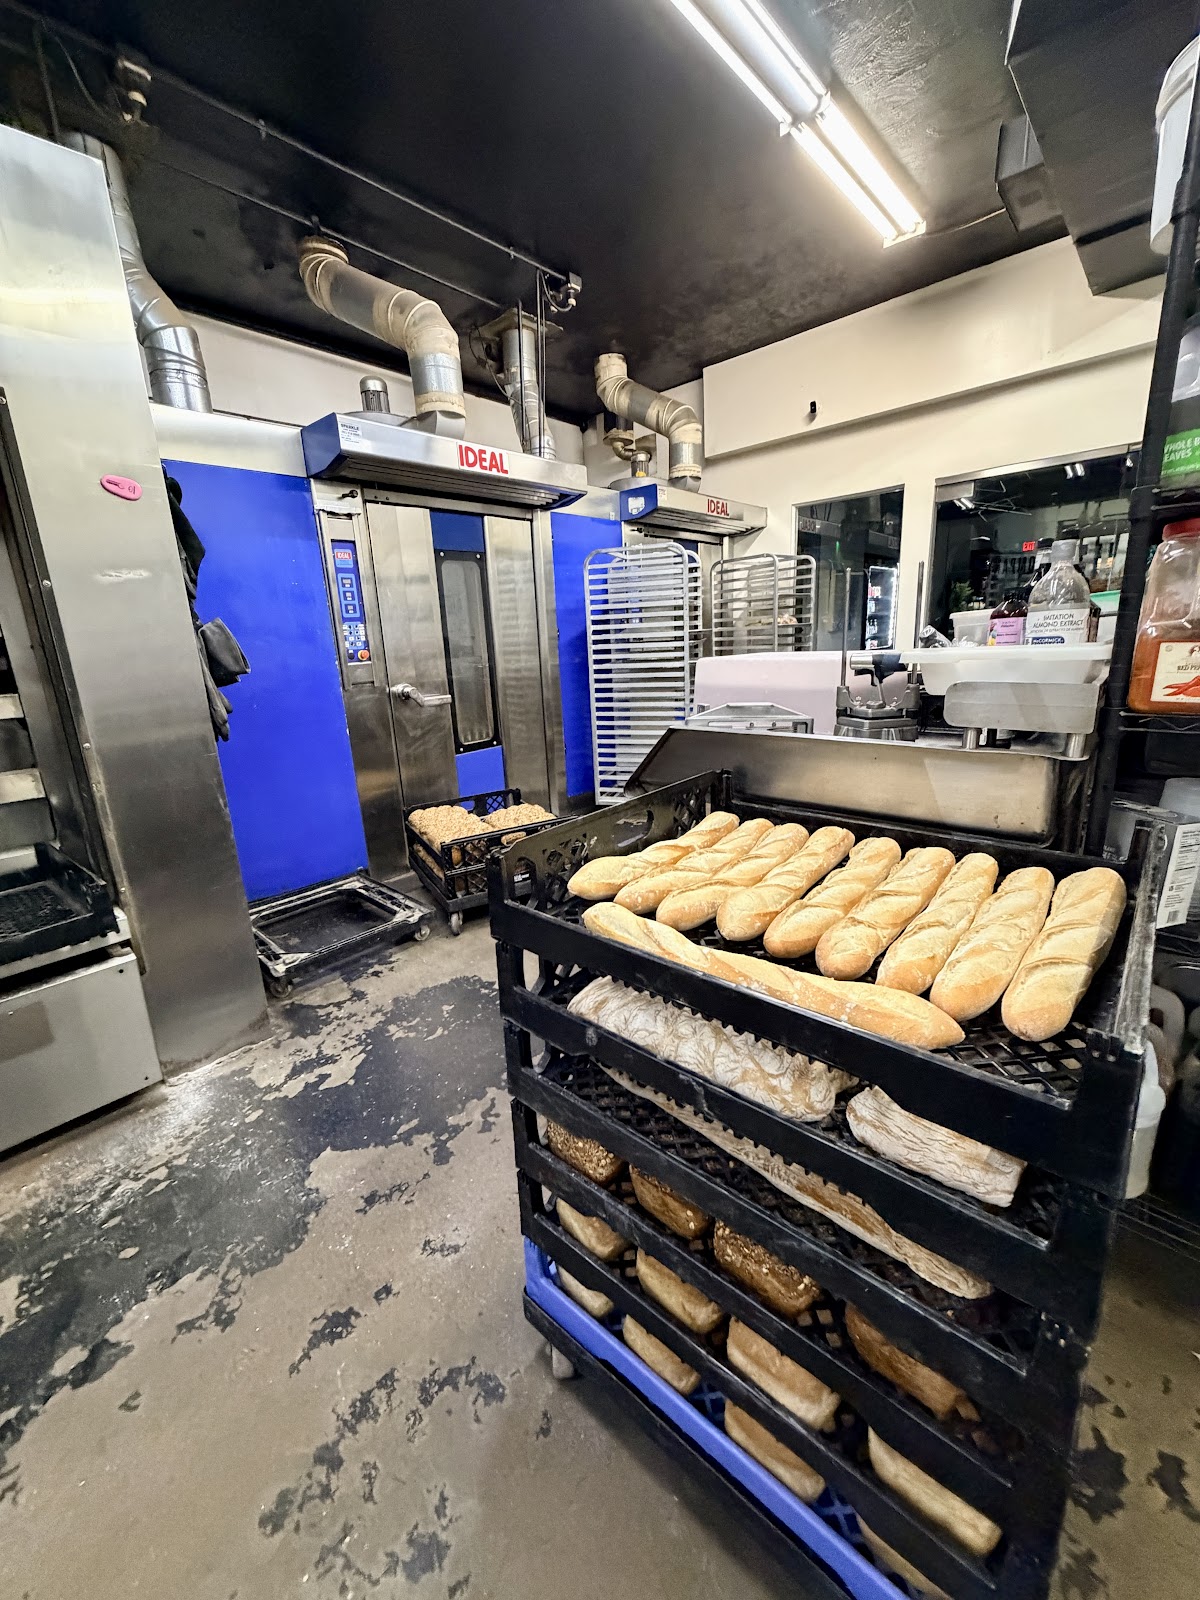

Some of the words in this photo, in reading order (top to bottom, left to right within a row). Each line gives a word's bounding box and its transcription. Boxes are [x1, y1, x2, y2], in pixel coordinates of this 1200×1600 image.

[458, 444, 509, 475] IDEAL
[707, 499, 730, 516] IDEAL
[1032, 621, 1059, 629] ALMOND
[1059, 619, 1084, 627] EXTRACT
